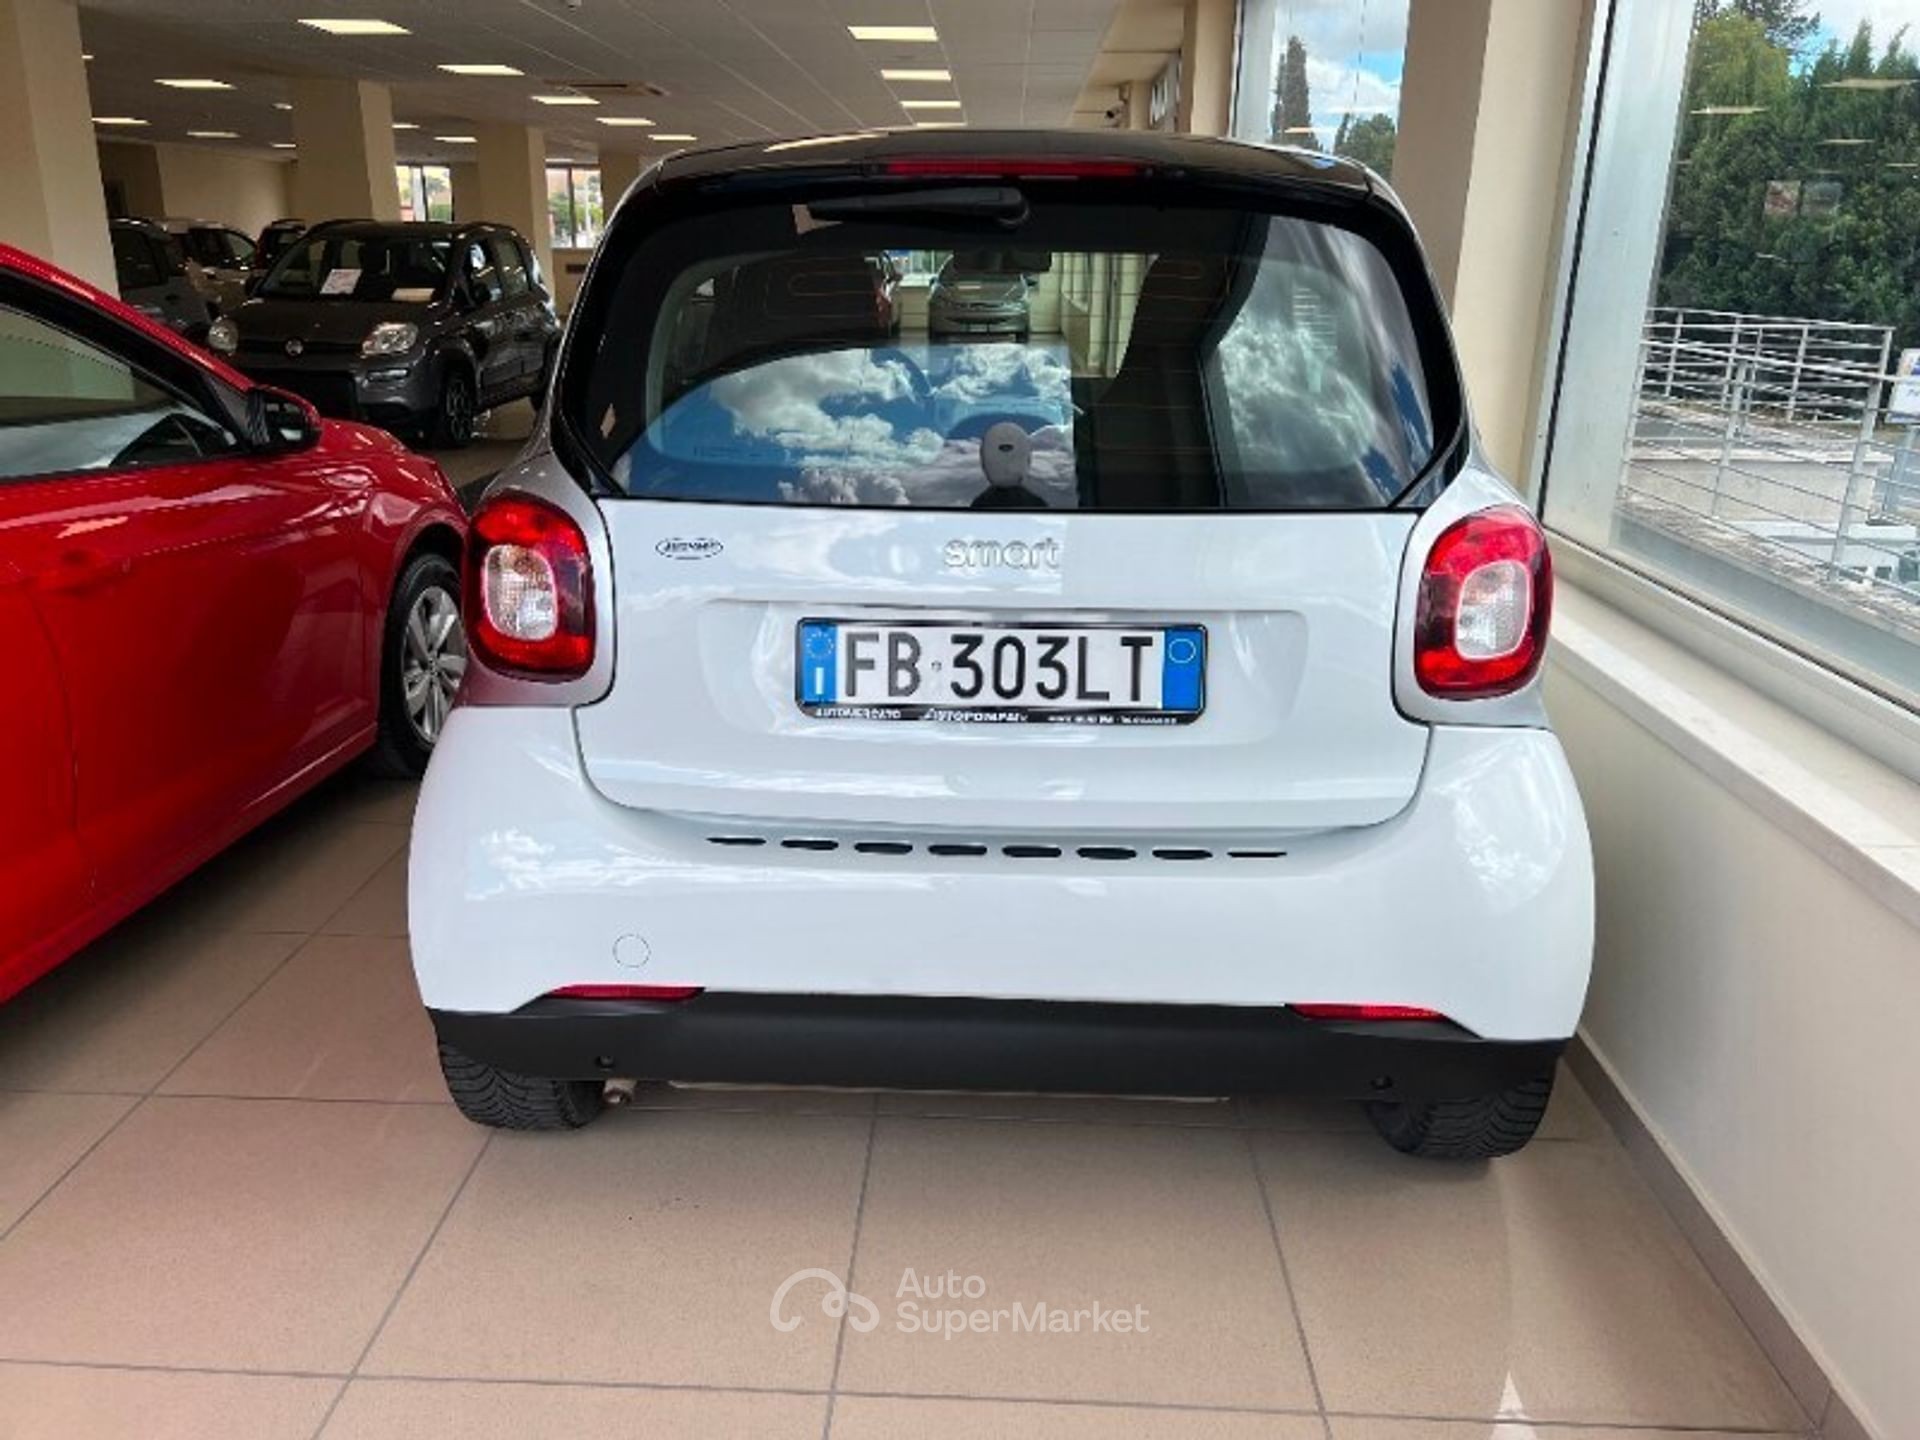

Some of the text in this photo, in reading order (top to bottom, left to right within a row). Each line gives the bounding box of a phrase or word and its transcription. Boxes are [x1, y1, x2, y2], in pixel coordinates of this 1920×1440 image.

[943, 538, 1060, 569] smart
[845, 631, 922, 698] FB
[950, 634, 1154, 702] 303LT
